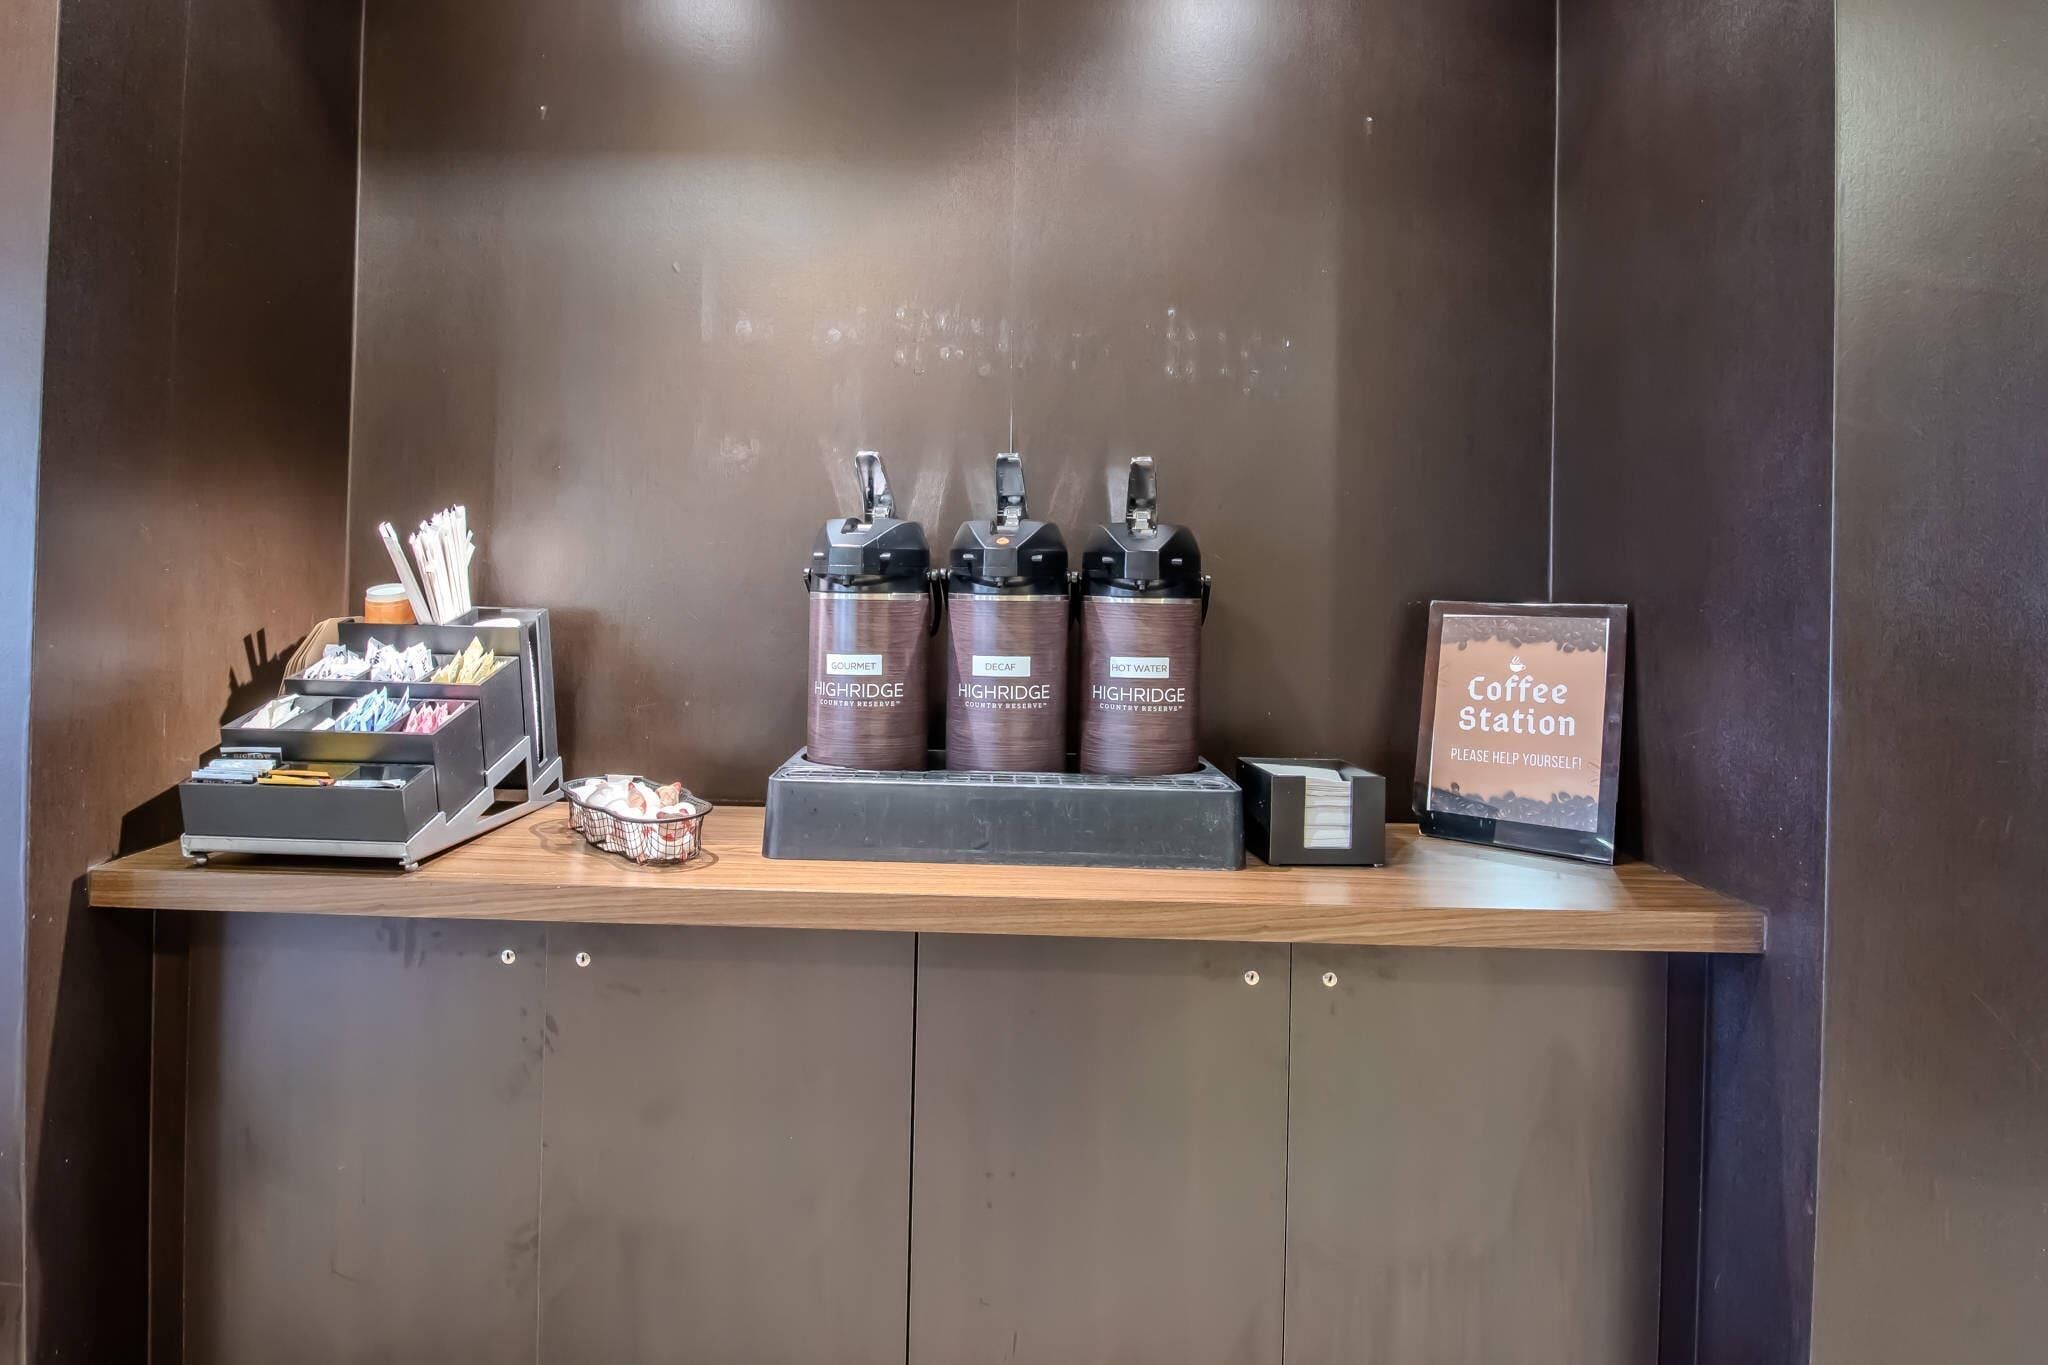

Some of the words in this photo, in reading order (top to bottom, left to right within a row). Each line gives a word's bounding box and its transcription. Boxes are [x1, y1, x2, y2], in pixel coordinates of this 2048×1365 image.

[831, 661, 876, 671] GOURMET
[985, 663, 1016, 671] DECAF
[1111, 663, 1132, 672] HOT
[1134, 664, 1168, 673] WATER
[814, 680, 904, 698] HIGHRIDGE
[958, 683, 1051, 700] HIGHRIDGE
[1092, 684, 1186, 703] HIGHRIDGE
[1467, 674, 1568, 705] Coffee
[820, 698, 854, 707] COUNTRY
[964, 701, 1003, 709] COUNTRY
[1099, 702, 1138, 711] COUNTRY
[1458, 705, 1576, 737] Station
[1450, 747, 1489, 763] PLEASE
[1492, 751, 1519, 765] HELP
[1522, 753, 1583, 770] YOURSELF!
